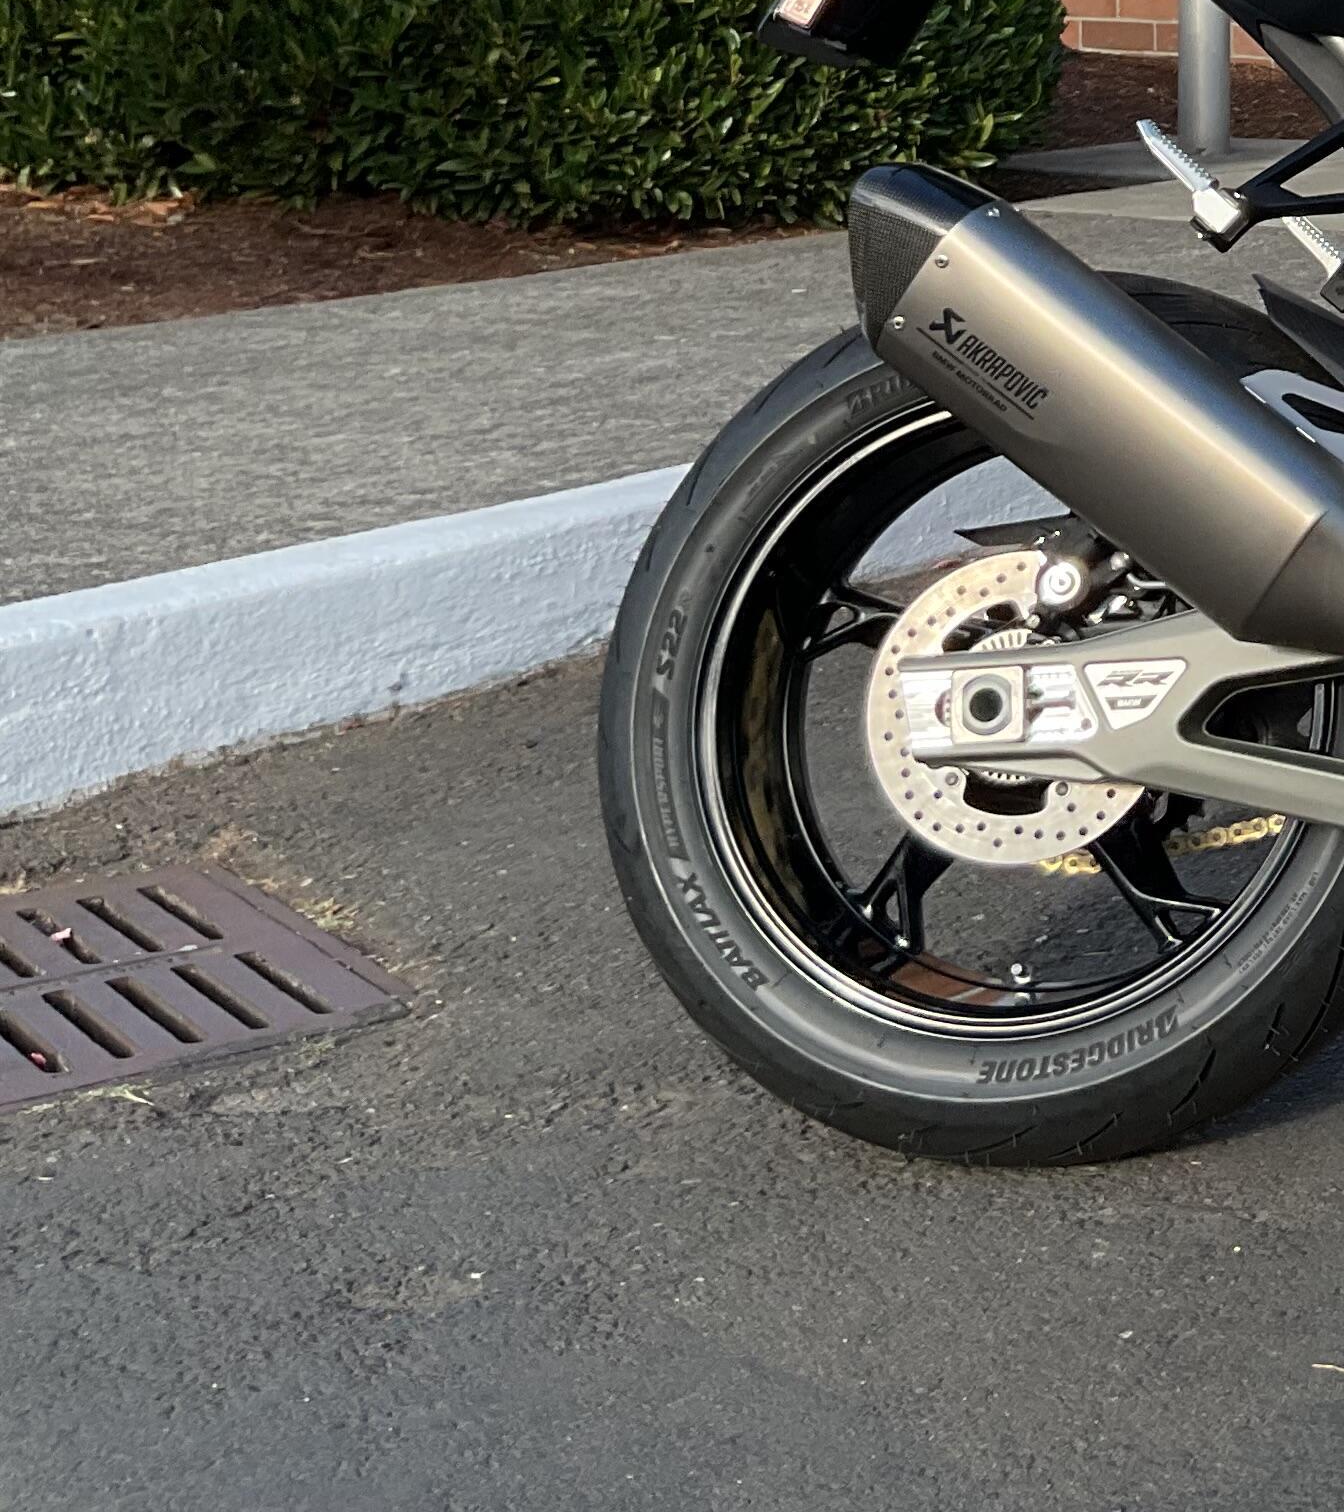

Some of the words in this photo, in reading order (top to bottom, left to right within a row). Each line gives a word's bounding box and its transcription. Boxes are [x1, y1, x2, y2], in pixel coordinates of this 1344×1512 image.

[656, 608, 689, 680] S22
[674, 871, 770, 990] BATTLAX
[978, 1009, 1183, 1086] BRIDGESTONE
